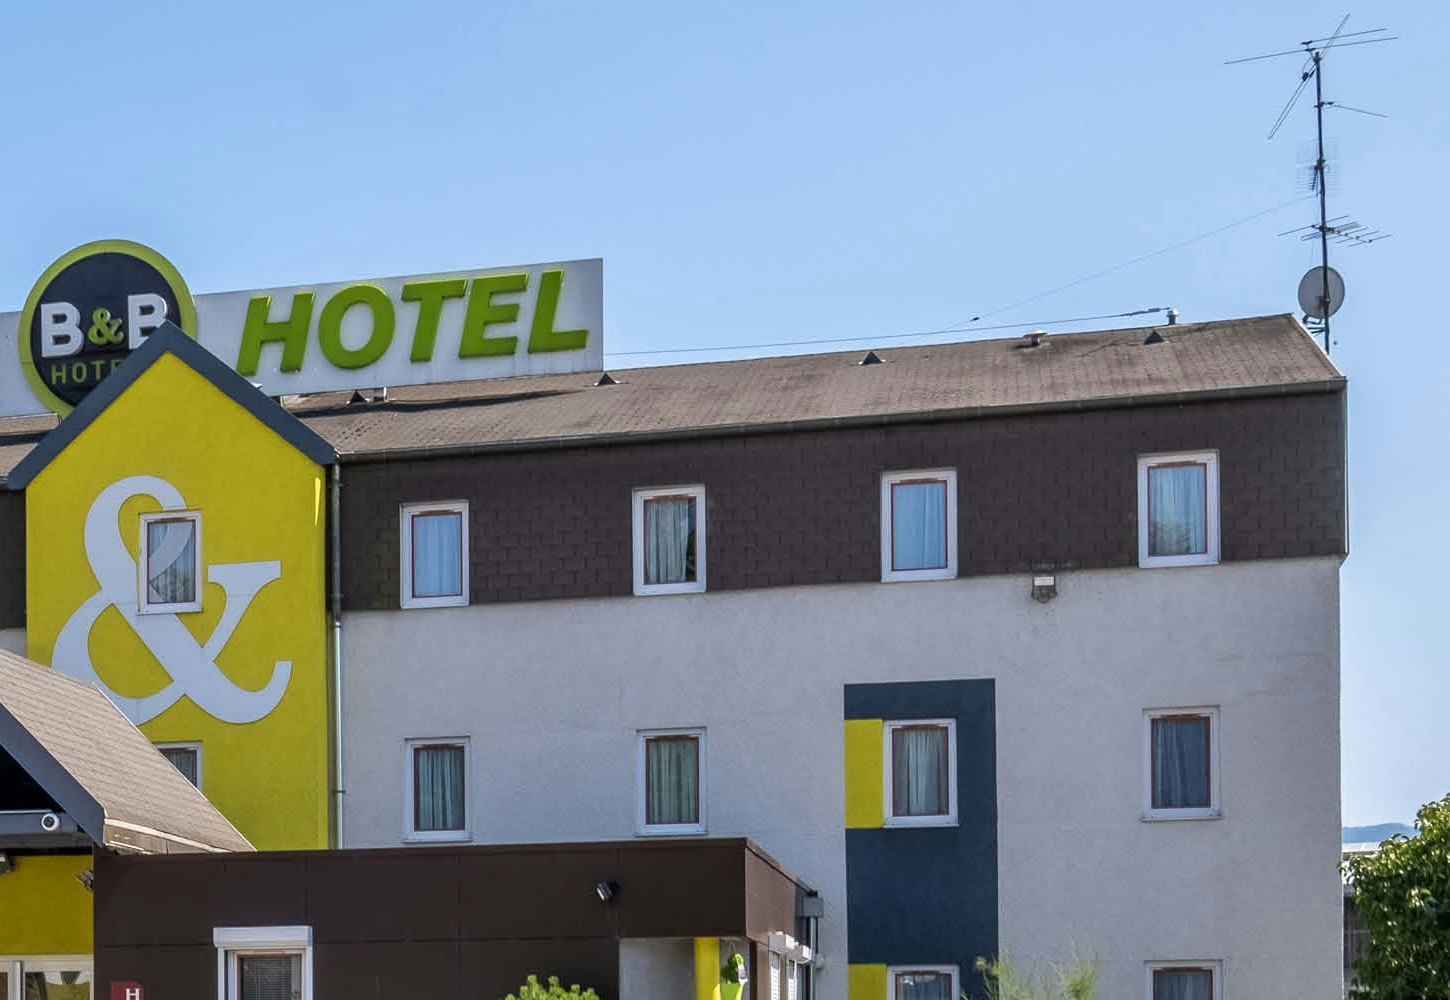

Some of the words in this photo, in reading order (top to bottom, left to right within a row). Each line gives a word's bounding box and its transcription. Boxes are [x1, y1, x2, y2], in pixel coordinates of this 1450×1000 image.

[40, 293, 168, 358] B&B
[235, 270, 590, 376] HOTEL
[51, 475, 293, 725] &
